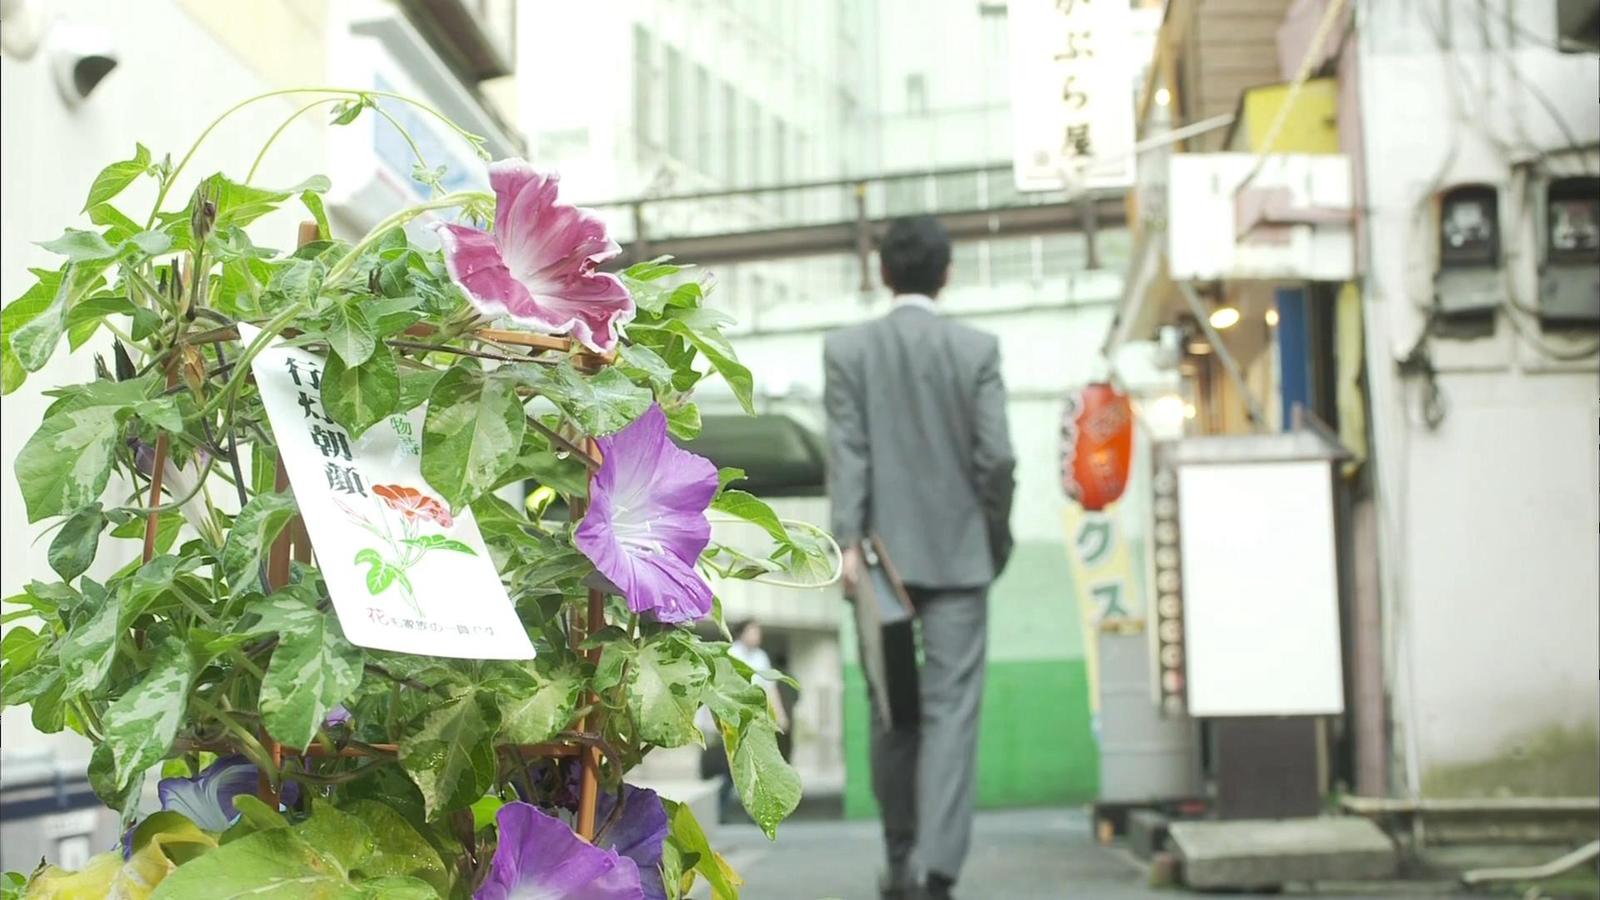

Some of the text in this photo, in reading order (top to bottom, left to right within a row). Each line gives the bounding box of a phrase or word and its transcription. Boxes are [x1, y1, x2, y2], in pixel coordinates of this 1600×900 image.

[284, 357, 368, 498] 行灯朝顔
[390, 412, 420, 456] 物詩
